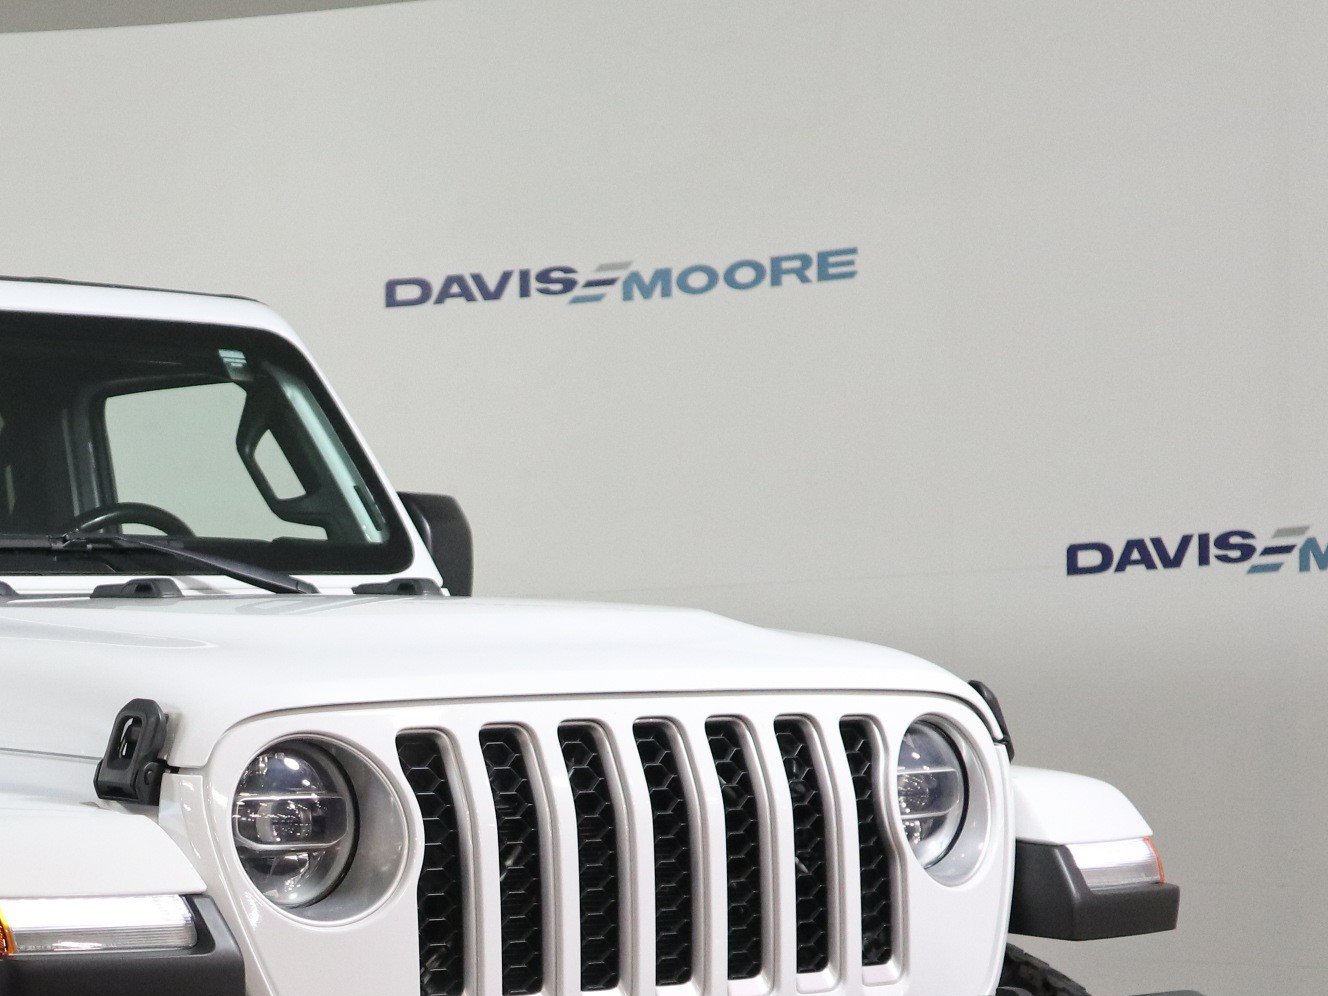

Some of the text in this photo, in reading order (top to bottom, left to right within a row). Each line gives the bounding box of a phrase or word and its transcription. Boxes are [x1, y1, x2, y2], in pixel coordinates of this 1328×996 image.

[384, 247, 859, 308] DAVIS MOORE
[1066, 530, 1258, 576] DAVIS
